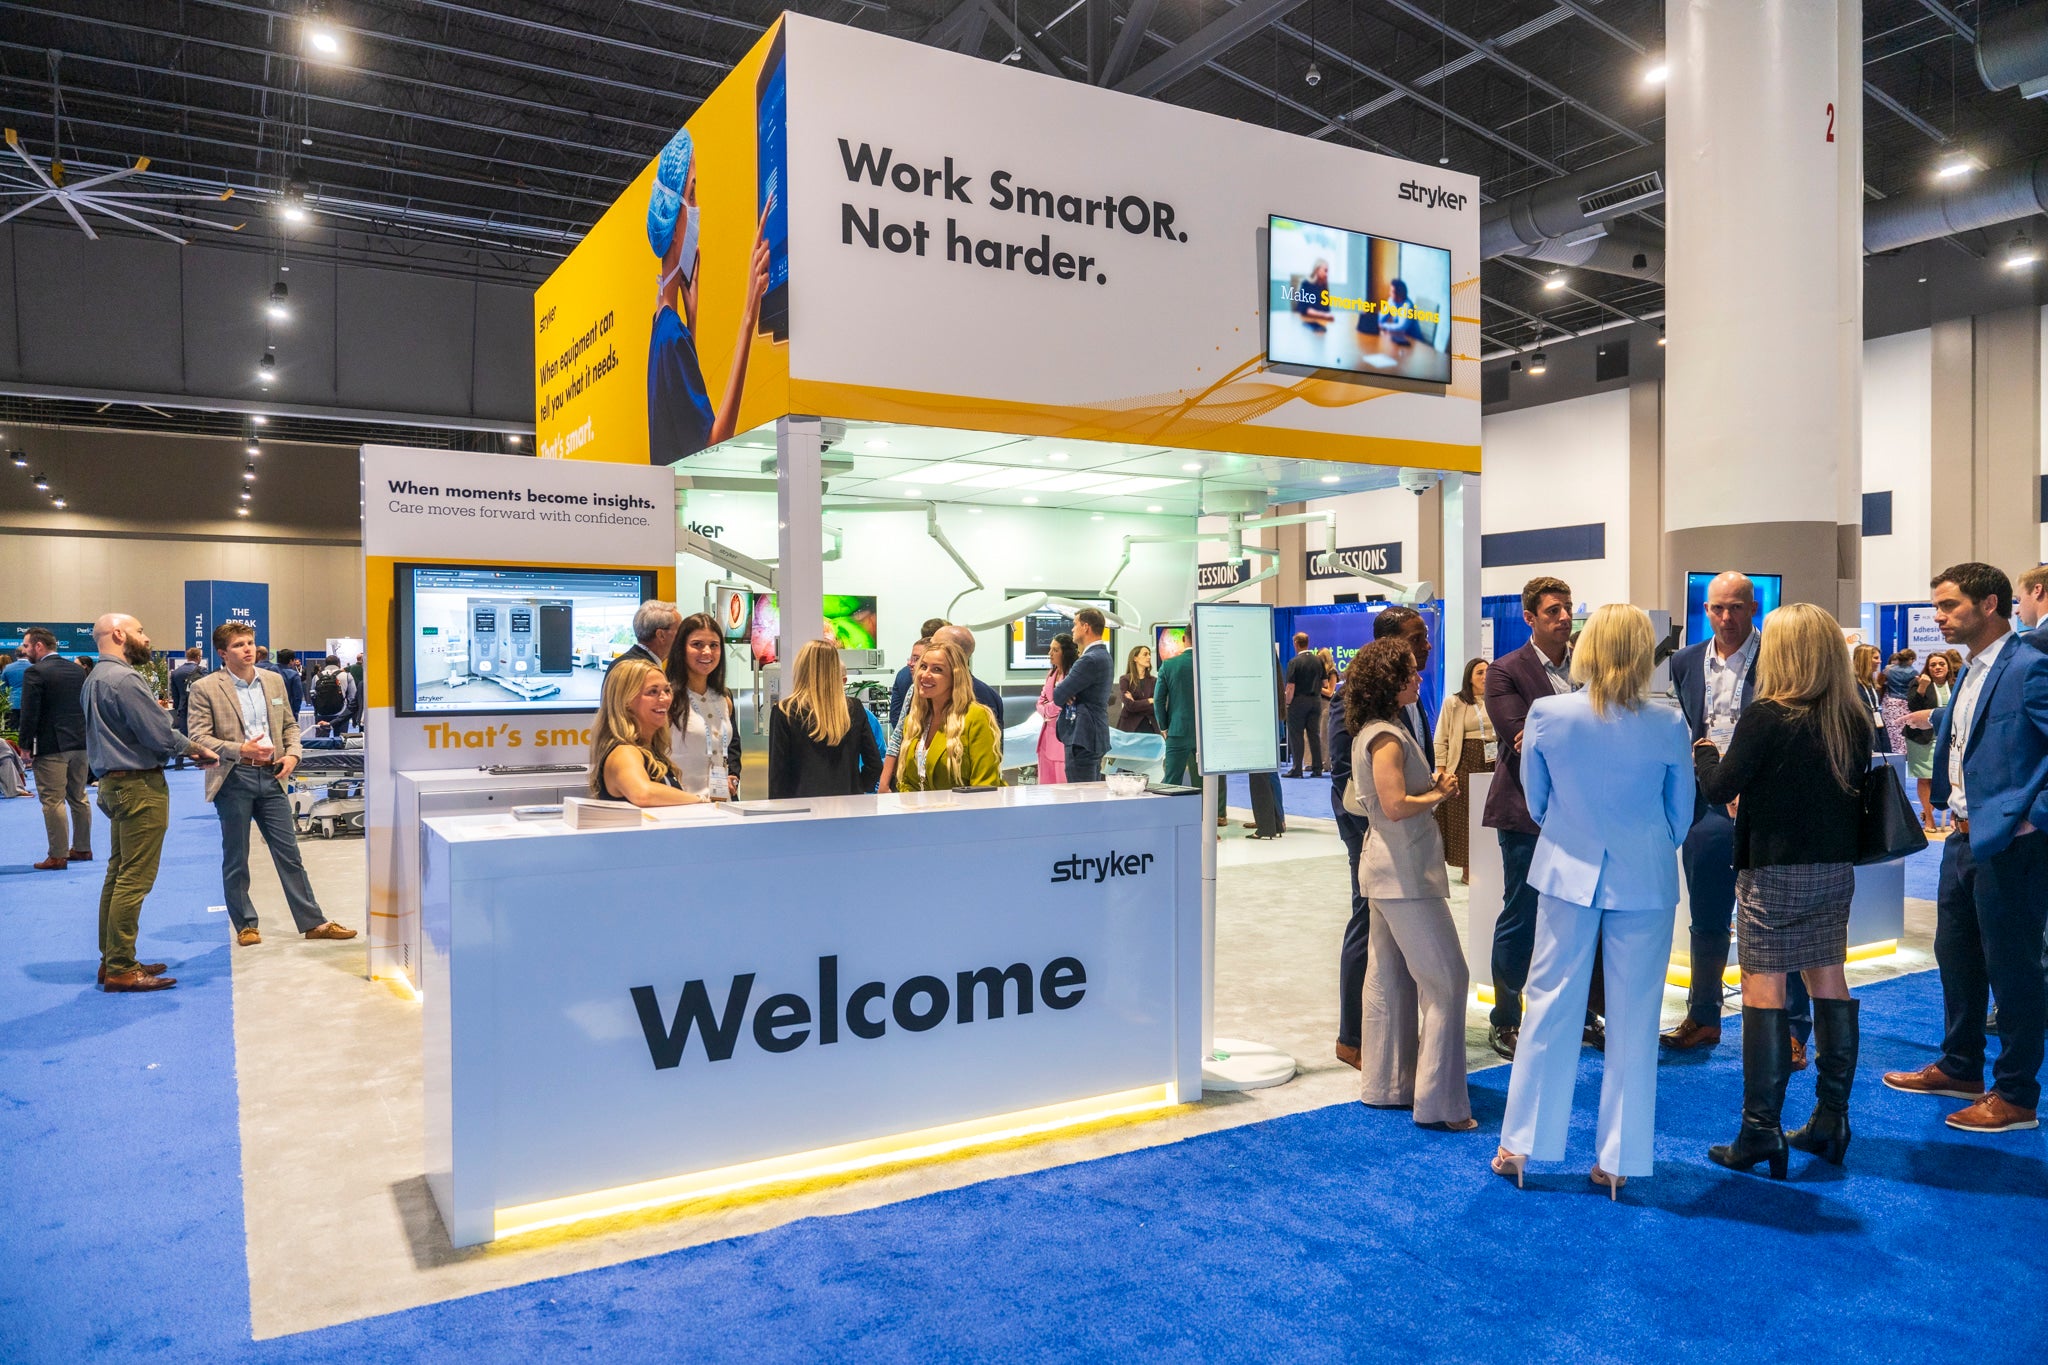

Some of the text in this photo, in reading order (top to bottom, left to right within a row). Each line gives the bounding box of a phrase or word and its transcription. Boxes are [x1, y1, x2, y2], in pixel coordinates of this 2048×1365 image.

[1826, 102, 1835, 143] 2
[837, 137, 1189, 244] Work SmartOR.
[1398, 179, 1468, 211] stryker
[842, 202, 1107, 286] Not harder.
[539, 305, 557, 334] stryker
[1280, 285, 1440, 324] Make Smarter Decisions
[540, 310, 614, 388] When equipment can
[540, 343, 619, 423] tell you what it needs.
[565, 415, 595, 455] smart.
[388, 480, 656, 511] When moments become insights.
[388, 500, 651, 527] Care moves forward with confidence.
[1198, 565, 1240, 586] CESSIONS
[195, 613, 203, 638] THE
[231, 607, 250, 617] THE
[1913, 625, 1940, 634] Adhesiv
[1913, 634, 1941, 642] Medical
[418, 695, 444, 703] stryker
[423, 721, 522, 749] That's
[1050, 850, 1154, 884] stryker
[629, 954, 1088, 1071] Welcome
